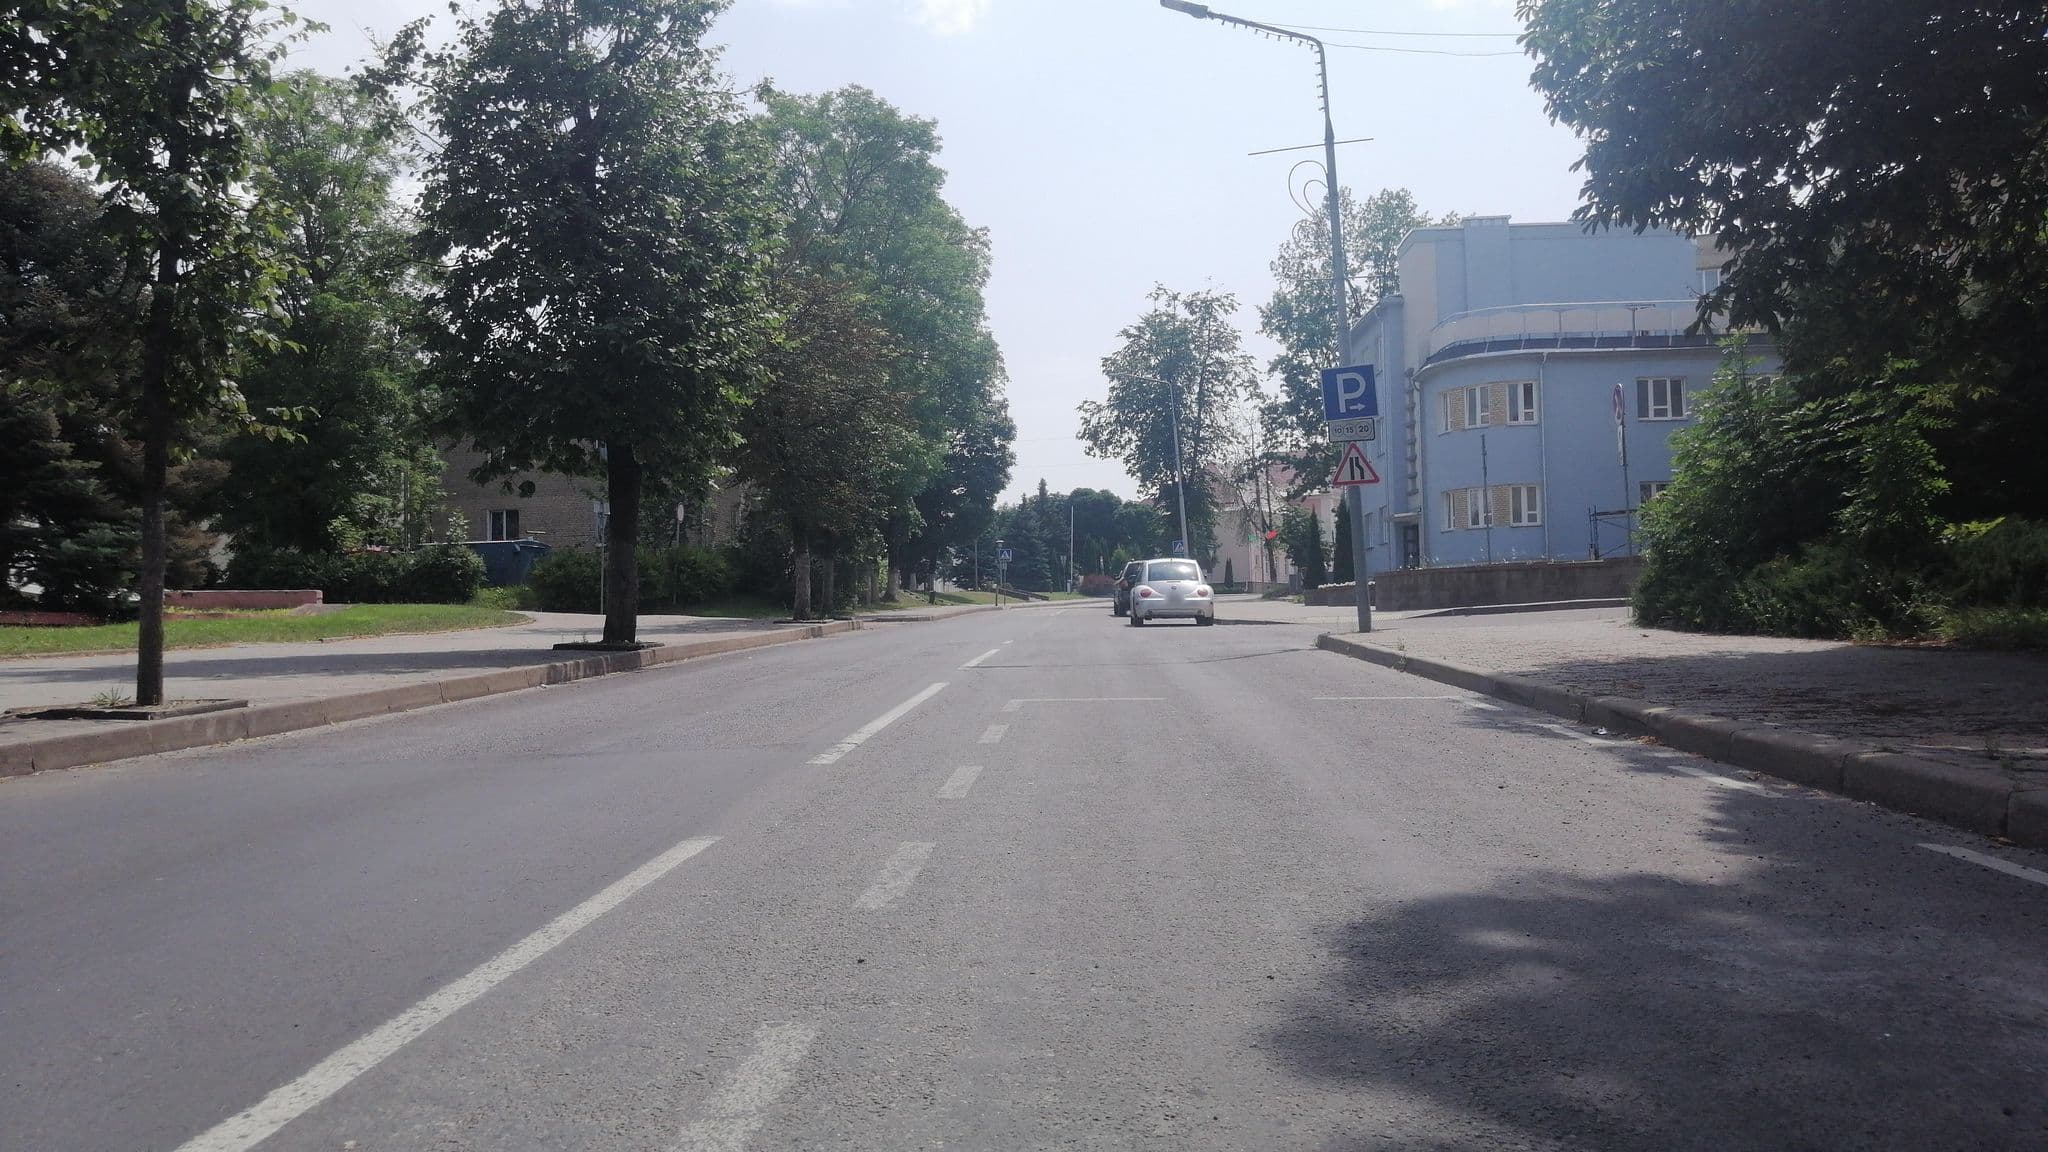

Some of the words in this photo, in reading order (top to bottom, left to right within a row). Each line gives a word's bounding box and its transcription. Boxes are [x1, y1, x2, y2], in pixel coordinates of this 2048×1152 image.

[1335, 372, 1366, 413] P
[1345, 426, 1354, 434] 15
[1358, 425, 1369, 433] 20
